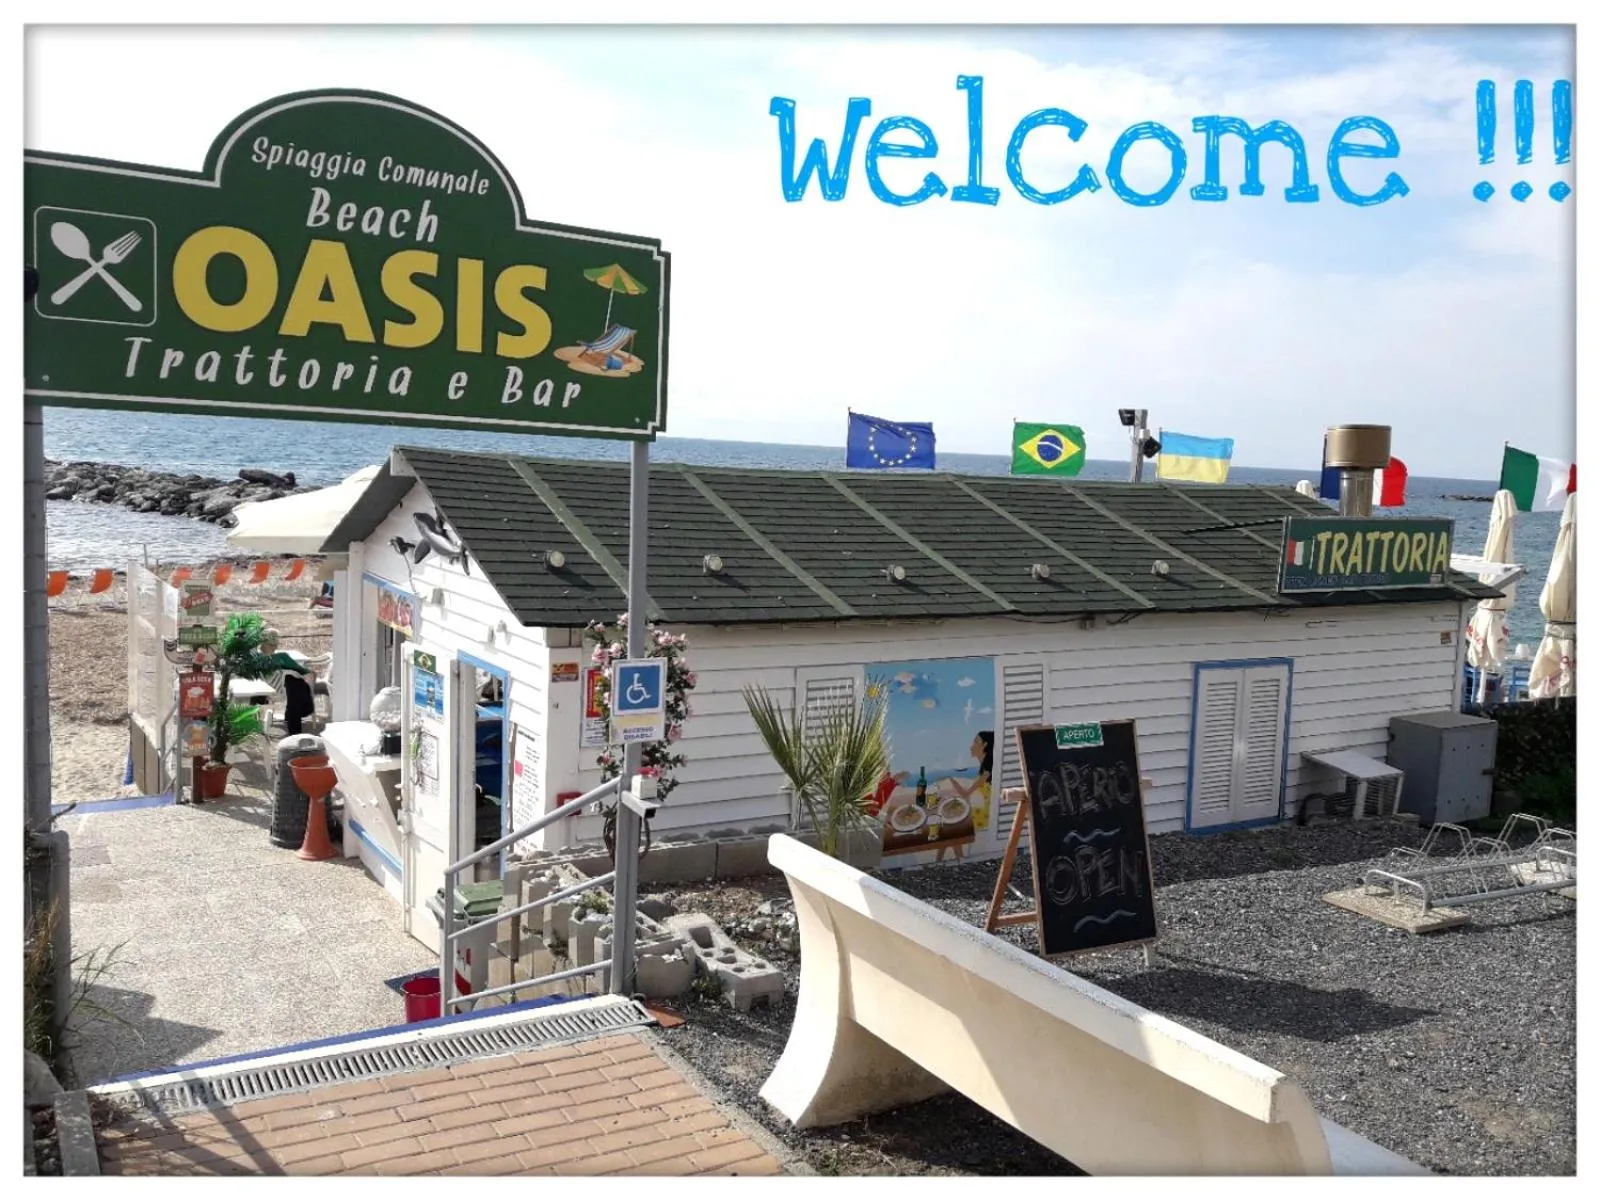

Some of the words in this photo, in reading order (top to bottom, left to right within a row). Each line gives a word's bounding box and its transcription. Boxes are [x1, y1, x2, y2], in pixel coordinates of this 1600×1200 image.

[251, 136, 367, 180] Spiaggia
[379, 157, 489, 195] Comunale
[306, 186, 438, 242] Beach
[172, 226, 552, 359] OASIS
[124, 336, 412, 397] Trattoria
[447, 371, 468, 400] e
[501, 366, 582, 408] Bar
[1315, 530, 1450, 576] TRATTORIA
[1063, 729, 1096, 741] APERTO
[1046, 845, 1144, 906] OPEN
